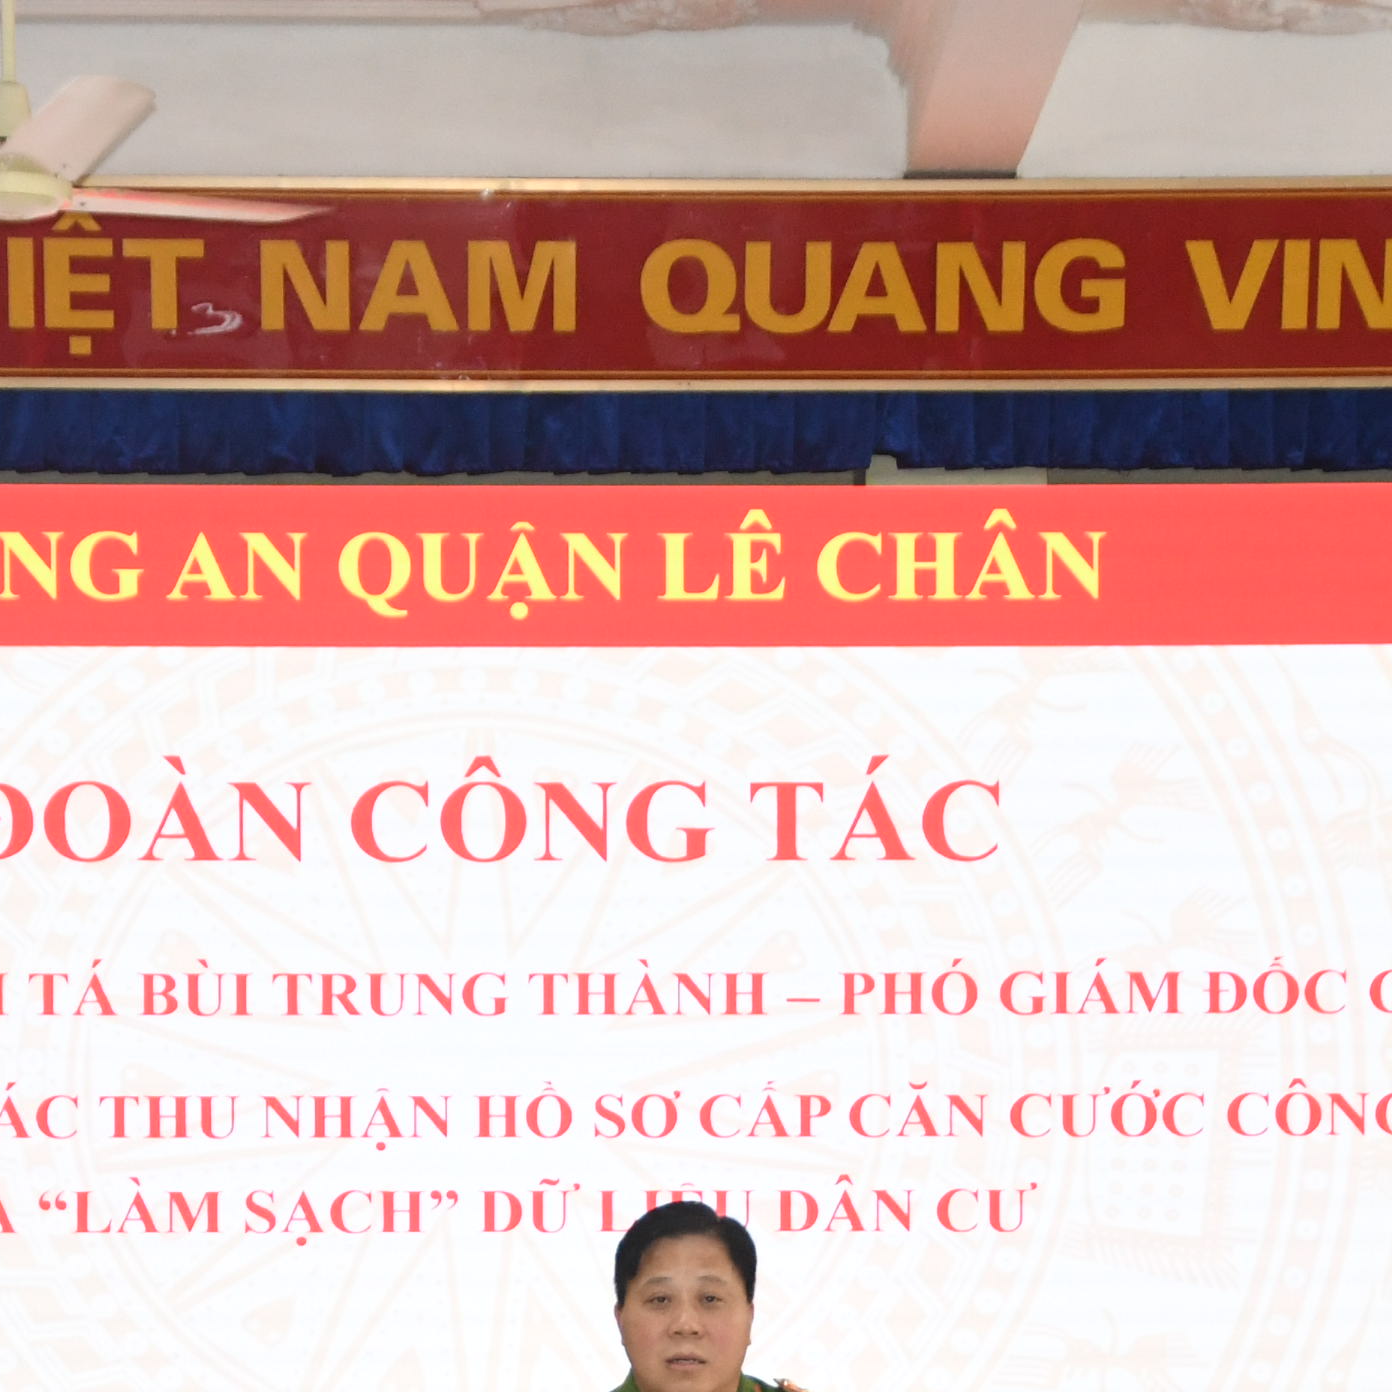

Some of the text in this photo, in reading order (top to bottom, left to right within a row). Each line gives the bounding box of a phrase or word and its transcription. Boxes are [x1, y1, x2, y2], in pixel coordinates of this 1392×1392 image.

[259, 239, 577, 333] NAM
[639, 237, 1127, 335] QUANG
[165, 532, 308, 601] AN
[337, 521, 628, 620] QUẬN
[657, 508, 787, 601] LÊ
[815, 508, 1107, 602] CHÂN
[349, 755, 714, 864] CÔNG
[748, 754, 1001, 863] TÁC
[27, 958, 118, 1018] TÁ
[141, 958, 252, 1018] BÙI
[271, 972, 508, 1018] TRUNG
[527, 958, 767, 1017] THÀNH
[840, 957, 980, 1017] PHÓ
[998, 957, 1181, 1017] GIÁM
[1202, 956, 1348, 1016] ĐỐC
[98, 1094, 239, 1140] THU
[260, 1087, 451, 1152] NHẬN
[475, 1081, 574, 1140] HỒ
[593, 1089, 682, 1140] SƠ
[698, 1080, 833, 1139] CẤP
[847, 1081, 989, 1139] CĂN
[1008, 1078, 1206, 1139] CƯỚC
[37, 1176, 221, 1235] “LÀM
[243, 1188, 460, 1248] SẠCH”
[482, 1178, 582, 1234] DỮ
[775, 1173, 913, 1233] DÂN
[935, 1182, 1039, 1233] CƯ
